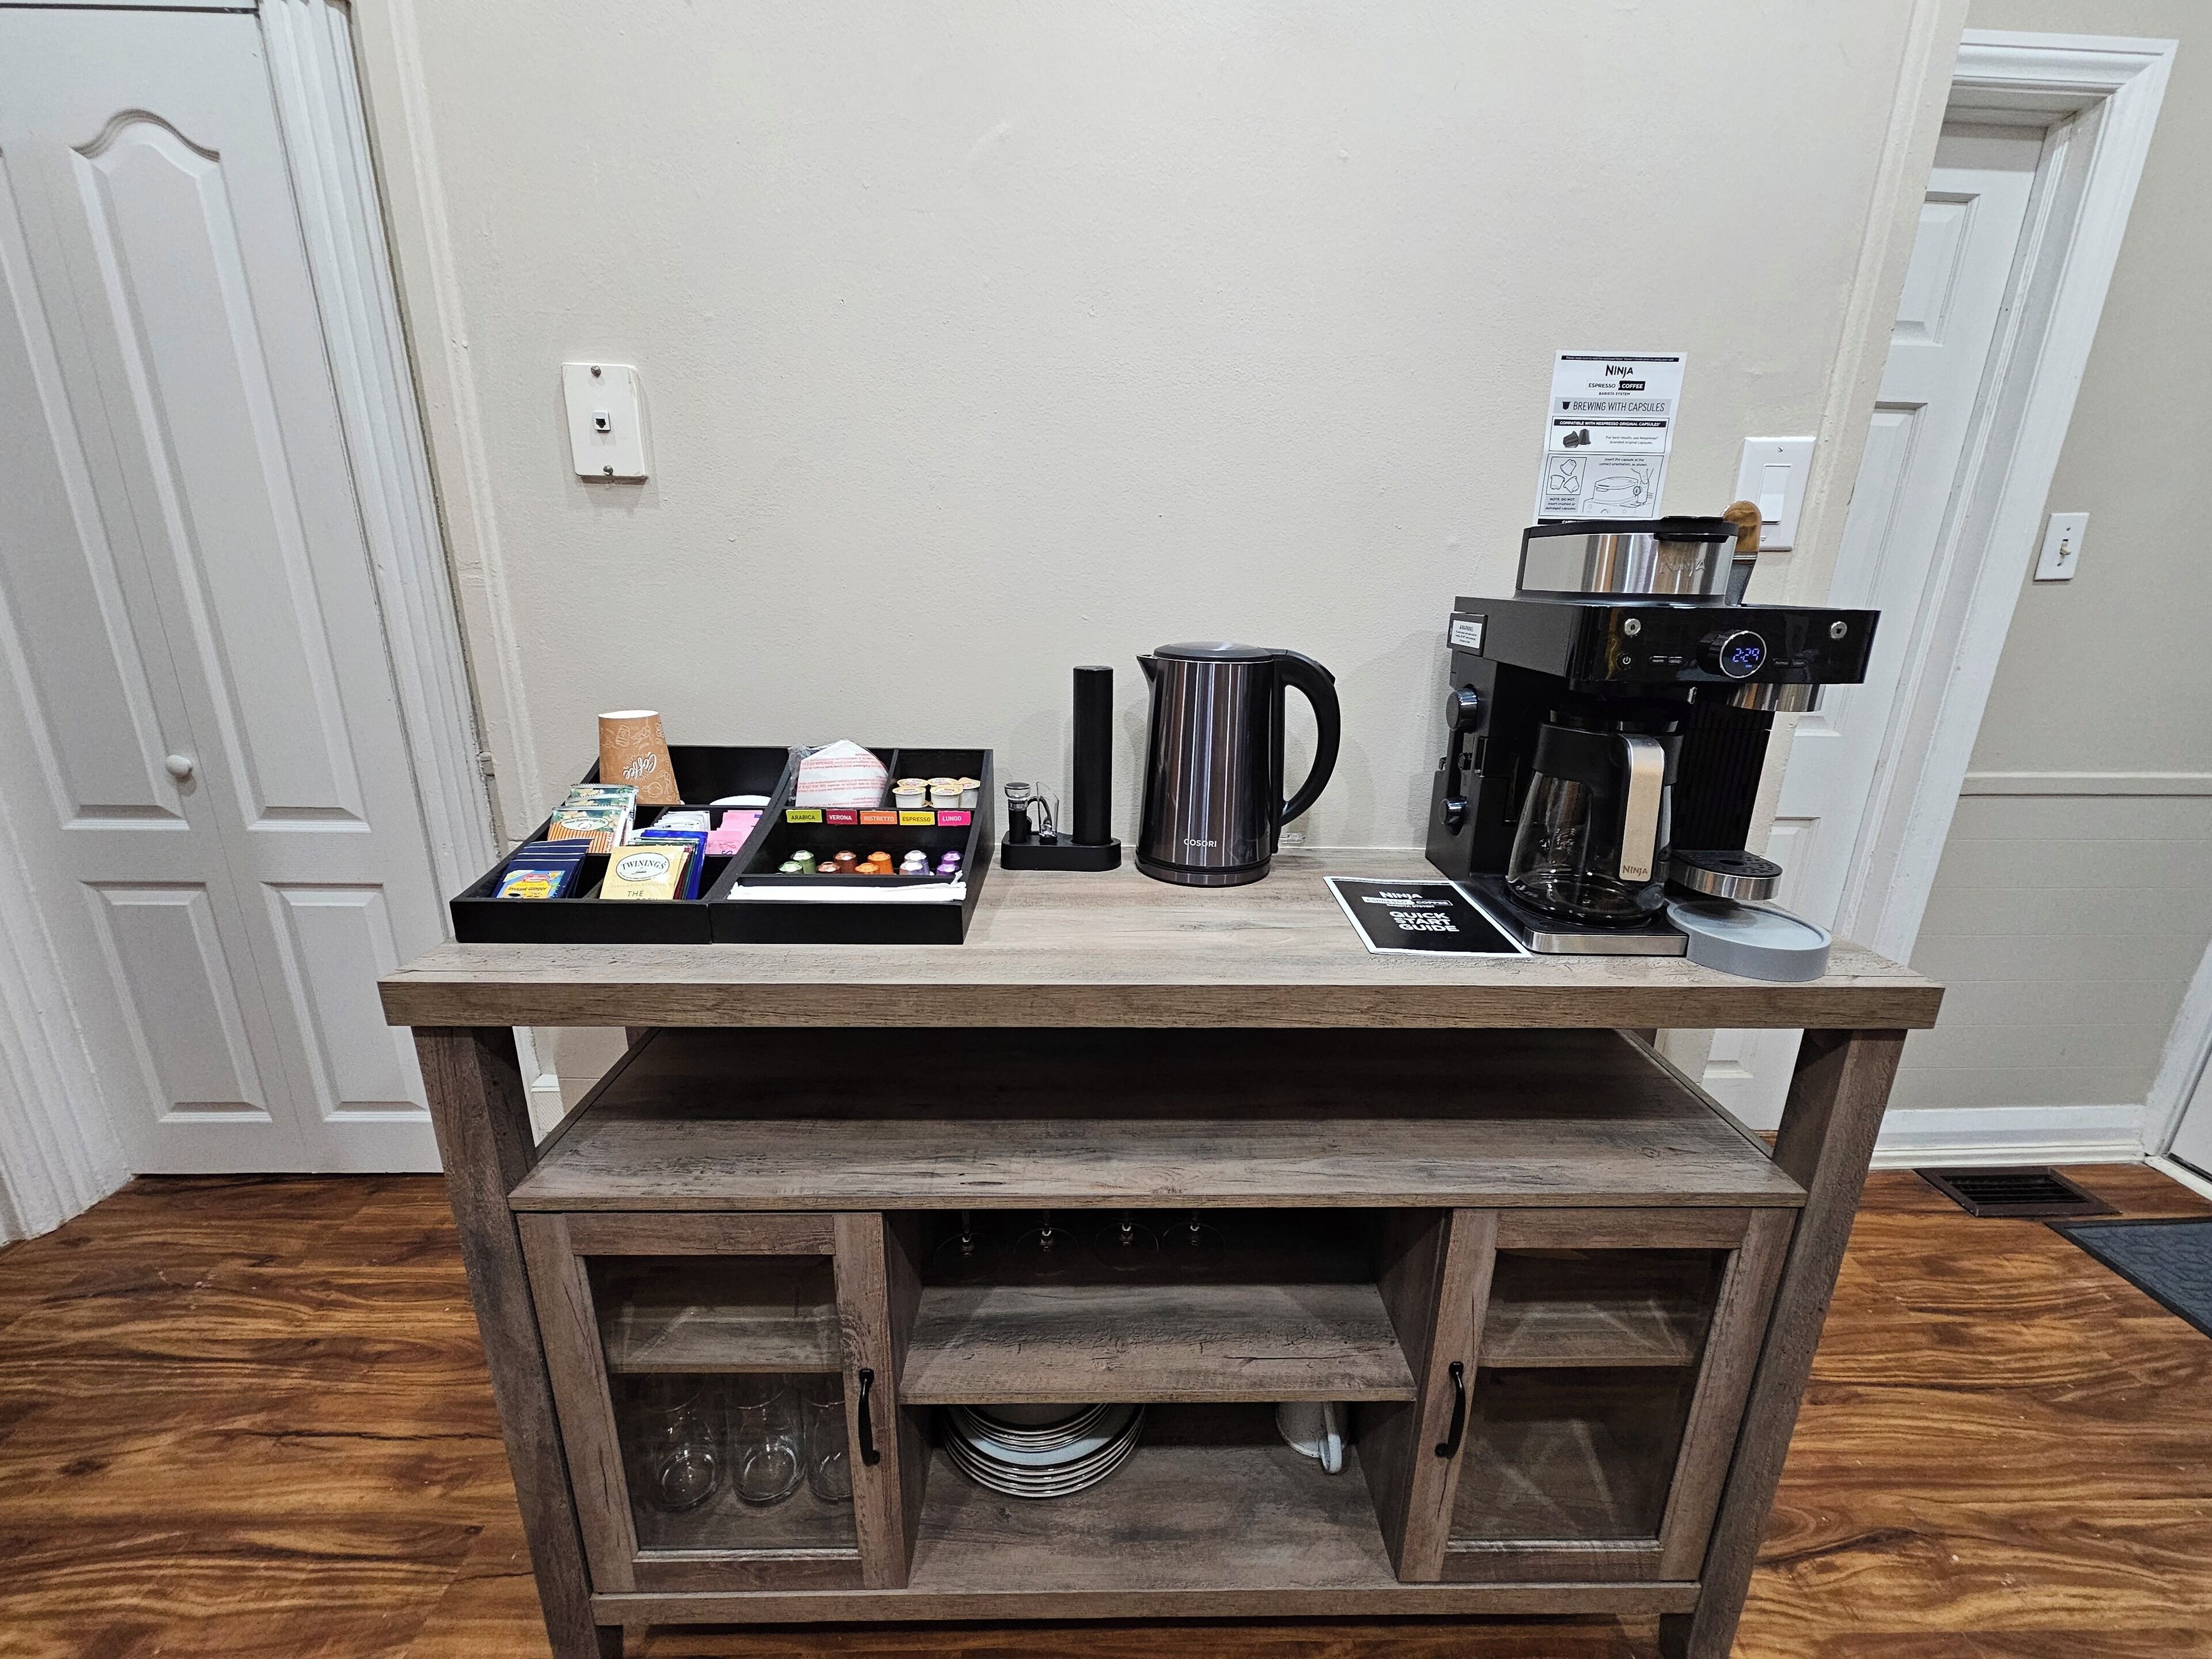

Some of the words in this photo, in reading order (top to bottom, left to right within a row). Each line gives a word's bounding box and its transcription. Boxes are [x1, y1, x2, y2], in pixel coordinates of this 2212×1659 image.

[1605, 364, 1634, 378] NINJA
[1573, 401, 1606, 411] BREWING
[1608, 402, 1626, 412] WITH
[1628, 402, 1665, 412] CAPSULES
[1732, 648, 1760, 662] 2:29
[623, 751, 657, 779] Coffee
[1184, 838, 1217, 847] COSORI
[621, 859, 666, 870] TWININGS
[1622, 865, 1648, 876] NINJA
[1379, 891, 1423, 899] NINJA
[1389, 911, 1449, 919] QUICK
[1393, 917, 1451, 925] START
[1399, 923, 1460, 932] GUIDE
